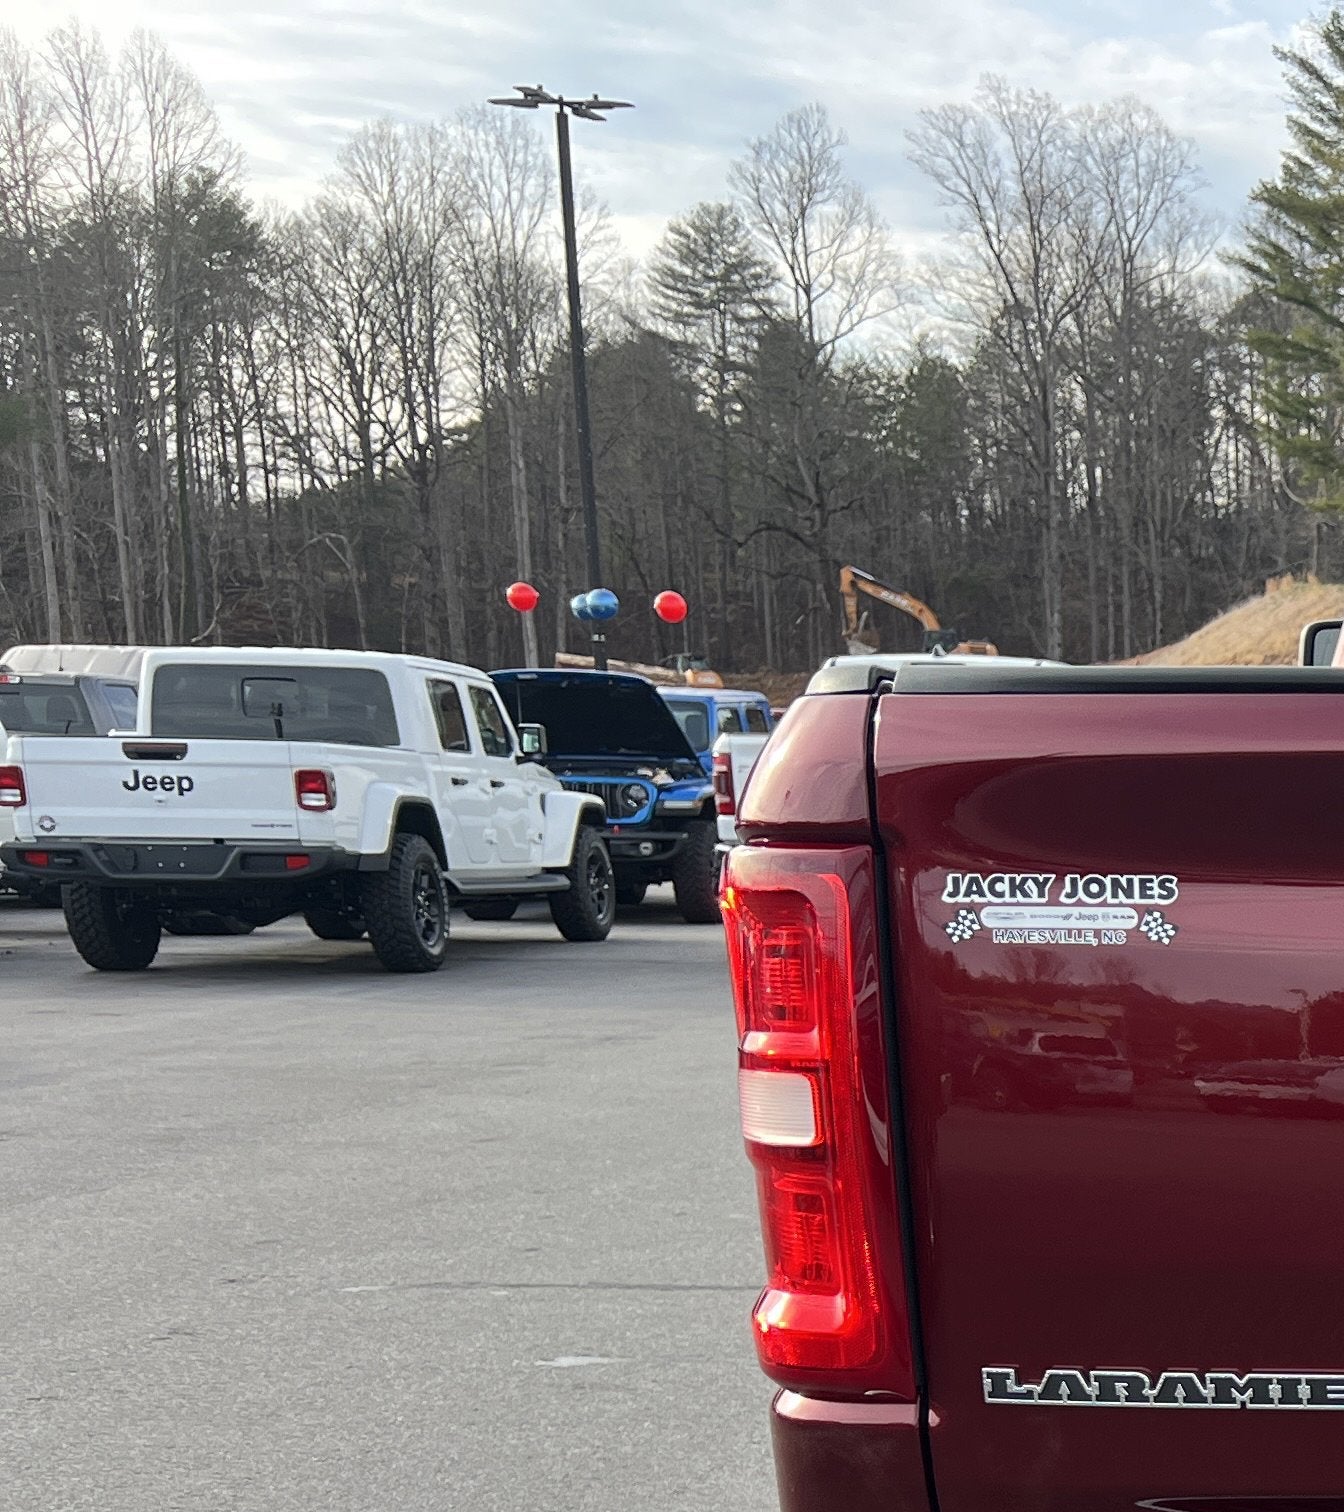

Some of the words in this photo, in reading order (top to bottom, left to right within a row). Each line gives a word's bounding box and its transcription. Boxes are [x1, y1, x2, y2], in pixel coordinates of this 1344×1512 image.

[121, 769, 195, 796] Jeep
[942, 873, 1055, 904] JACKY
[1059, 874, 1179, 905] JONES
[1074, 911, 1099, 922] Jeep
[992, 929, 1098, 946] HAYESVILLE,
[1101, 930, 1127, 945] NC
